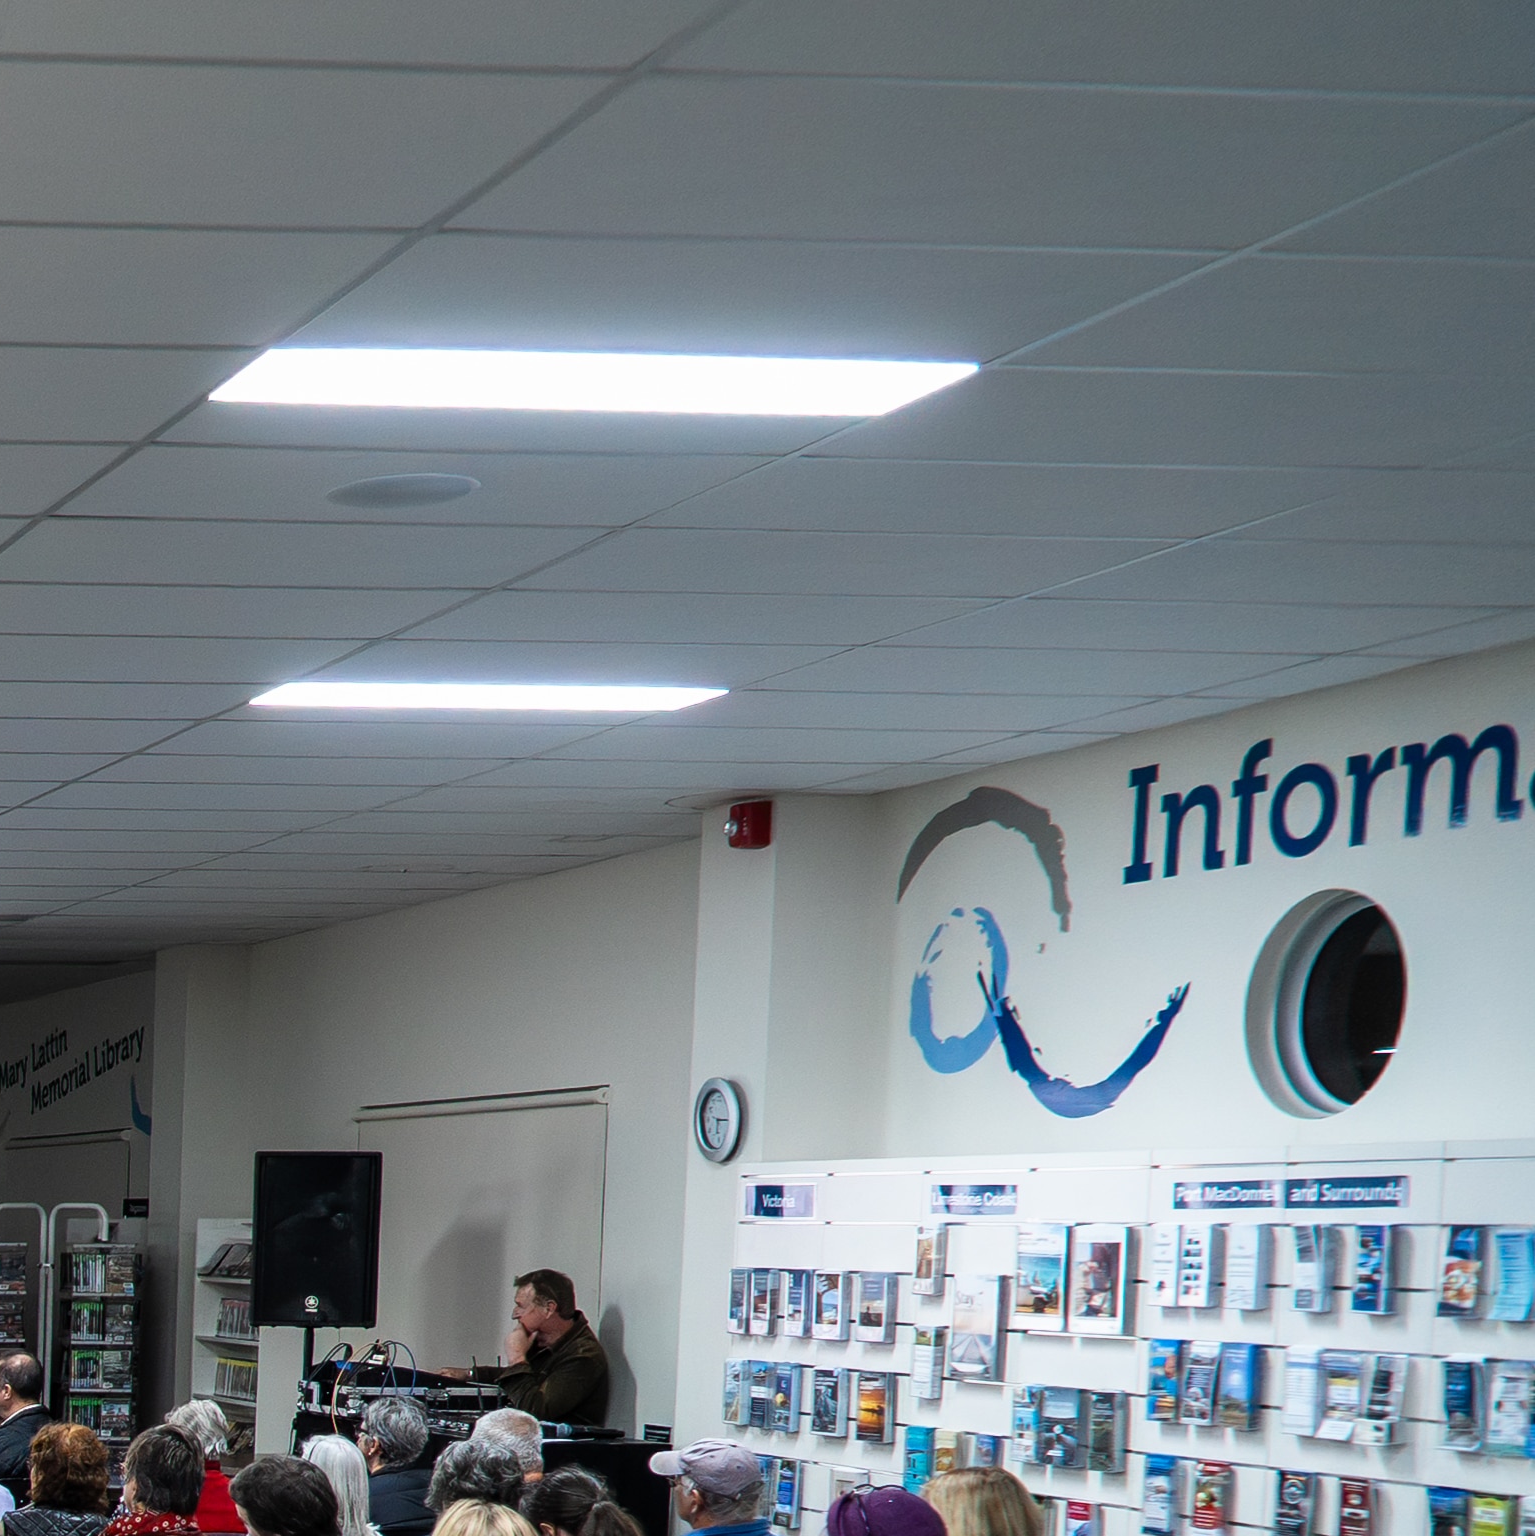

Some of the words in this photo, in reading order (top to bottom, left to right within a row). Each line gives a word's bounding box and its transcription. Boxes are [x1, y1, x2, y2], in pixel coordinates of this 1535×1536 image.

[1121, 723, 1528, 885] Inform
[30, 1051, 91, 1115] Memorial
[93, 1026, 145, 1077] Library
[31, 1027, 68, 1072] Lattin
[1321, 1183, 1403, 1201] Surrounds
